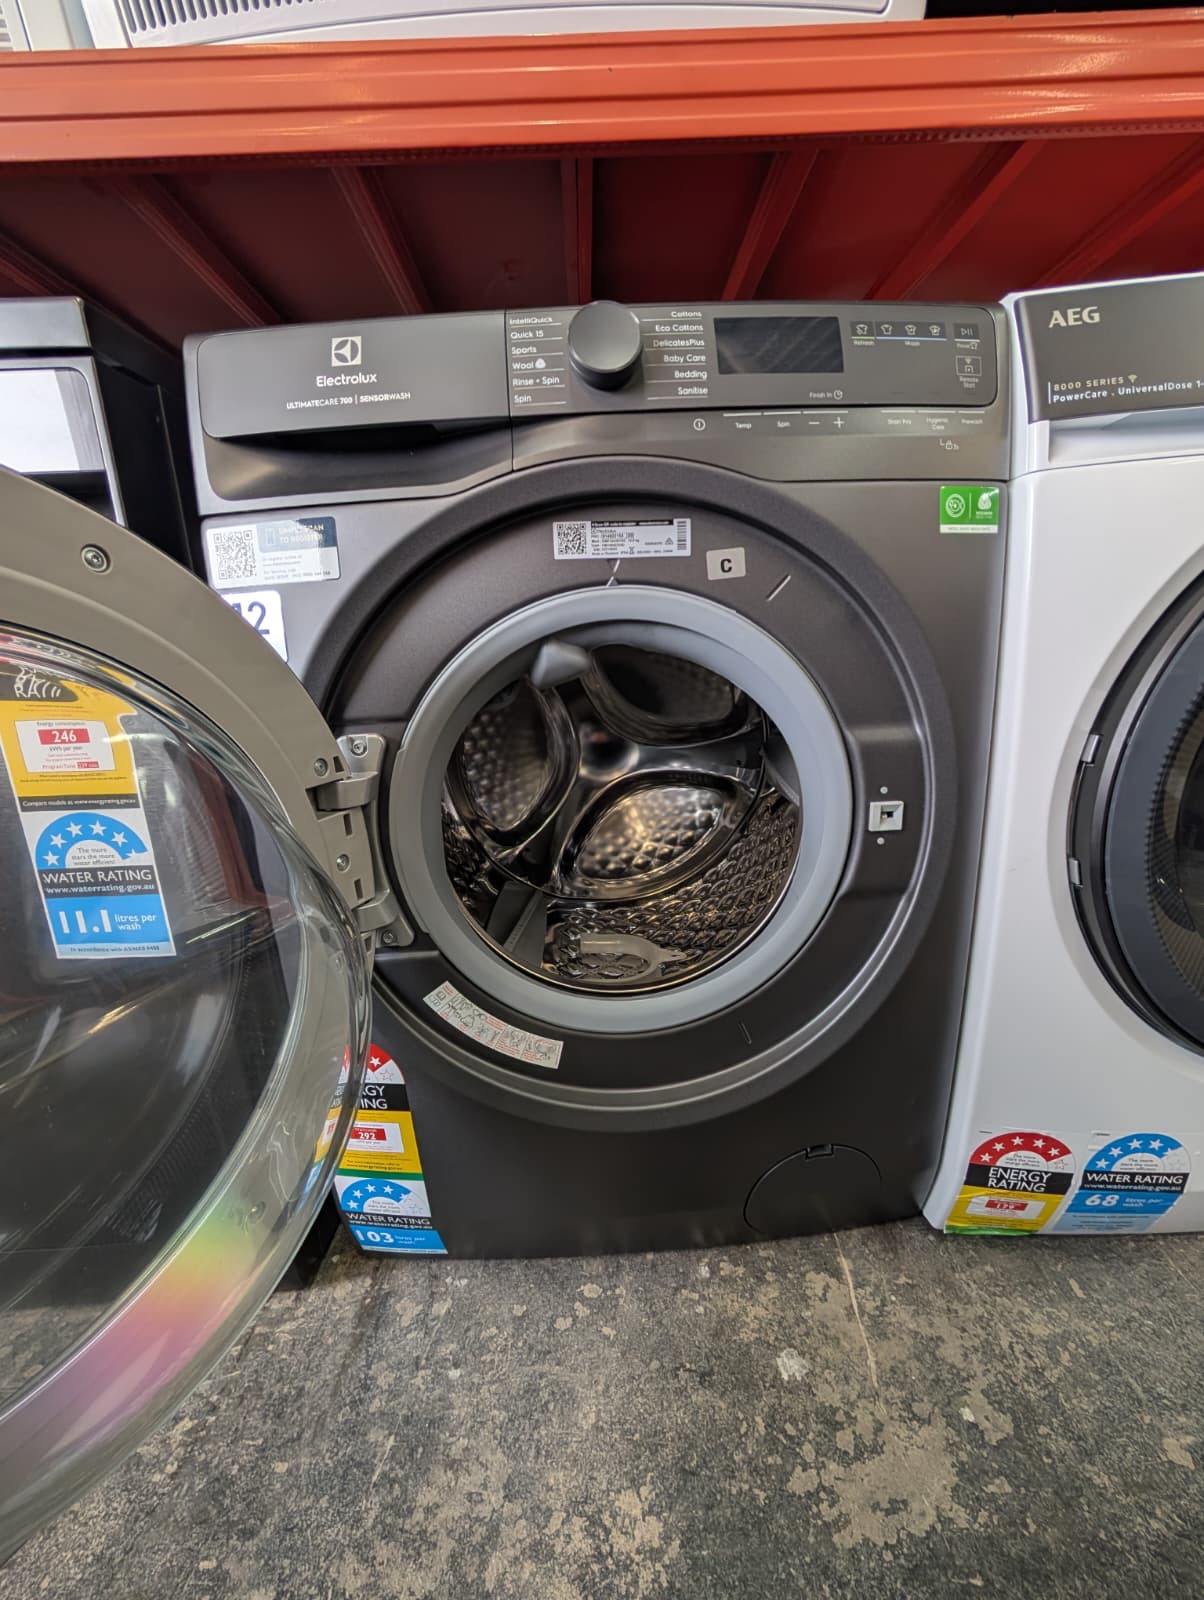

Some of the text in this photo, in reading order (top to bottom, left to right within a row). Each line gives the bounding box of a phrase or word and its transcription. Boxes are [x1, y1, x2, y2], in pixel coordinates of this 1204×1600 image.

[510, 316, 553, 325] IntelliQuick
[1048, 306, 1100, 328] AEG
[655, 323, 704, 332] Eco Cottons
[511, 331, 533, 340] Quick
[653, 338, 705, 348] DelicatesPlus
[511, 345, 537, 355] Sports
[663, 353, 707, 363] Baby Care
[512, 361, 534, 370] Wool
[316, 372, 378, 388] Electrolux
[674, 370, 708, 380] Bedding
[512, 377, 534, 387] Rinse
[542, 376, 560, 385] Spin
[1053, 376, 1124, 391] 8000 SERIES
[677, 386, 708, 395] Sanitise
[1053, 389, 1108, 403] PowerCare
[1117, 381, 1192, 395] UniversalDose
[286, 392, 411, 409] ULTIMATECARE 700 SENSORWASH
[513, 394, 532, 404] Spin
[720, 558, 733, 573] C
[52, 730, 77, 743] 246
[42, 869, 152, 884] WATER RATING
[46, 884, 155, 895] www.waterrating.gov.au
[58, 909, 113, 934] 11.1
[114, 914, 157, 923] litres per
[118, 922, 141, 930] wash
[361, 1098, 388, 1109] ING
[358, 1131, 376, 1140] 292
[989, 1167, 1052, 1184] ENERGY
[1086, 1172, 1184, 1184] WATER RATING
[987, 1178, 1047, 1192] RATING
[1084, 1184, 1181, 1192] www.waterrating.gov.au
[1085, 1194, 1120, 1206] 68
[345, 1212, 431, 1225] WATER RATING
[355, 1229, 394, 1243] 103
